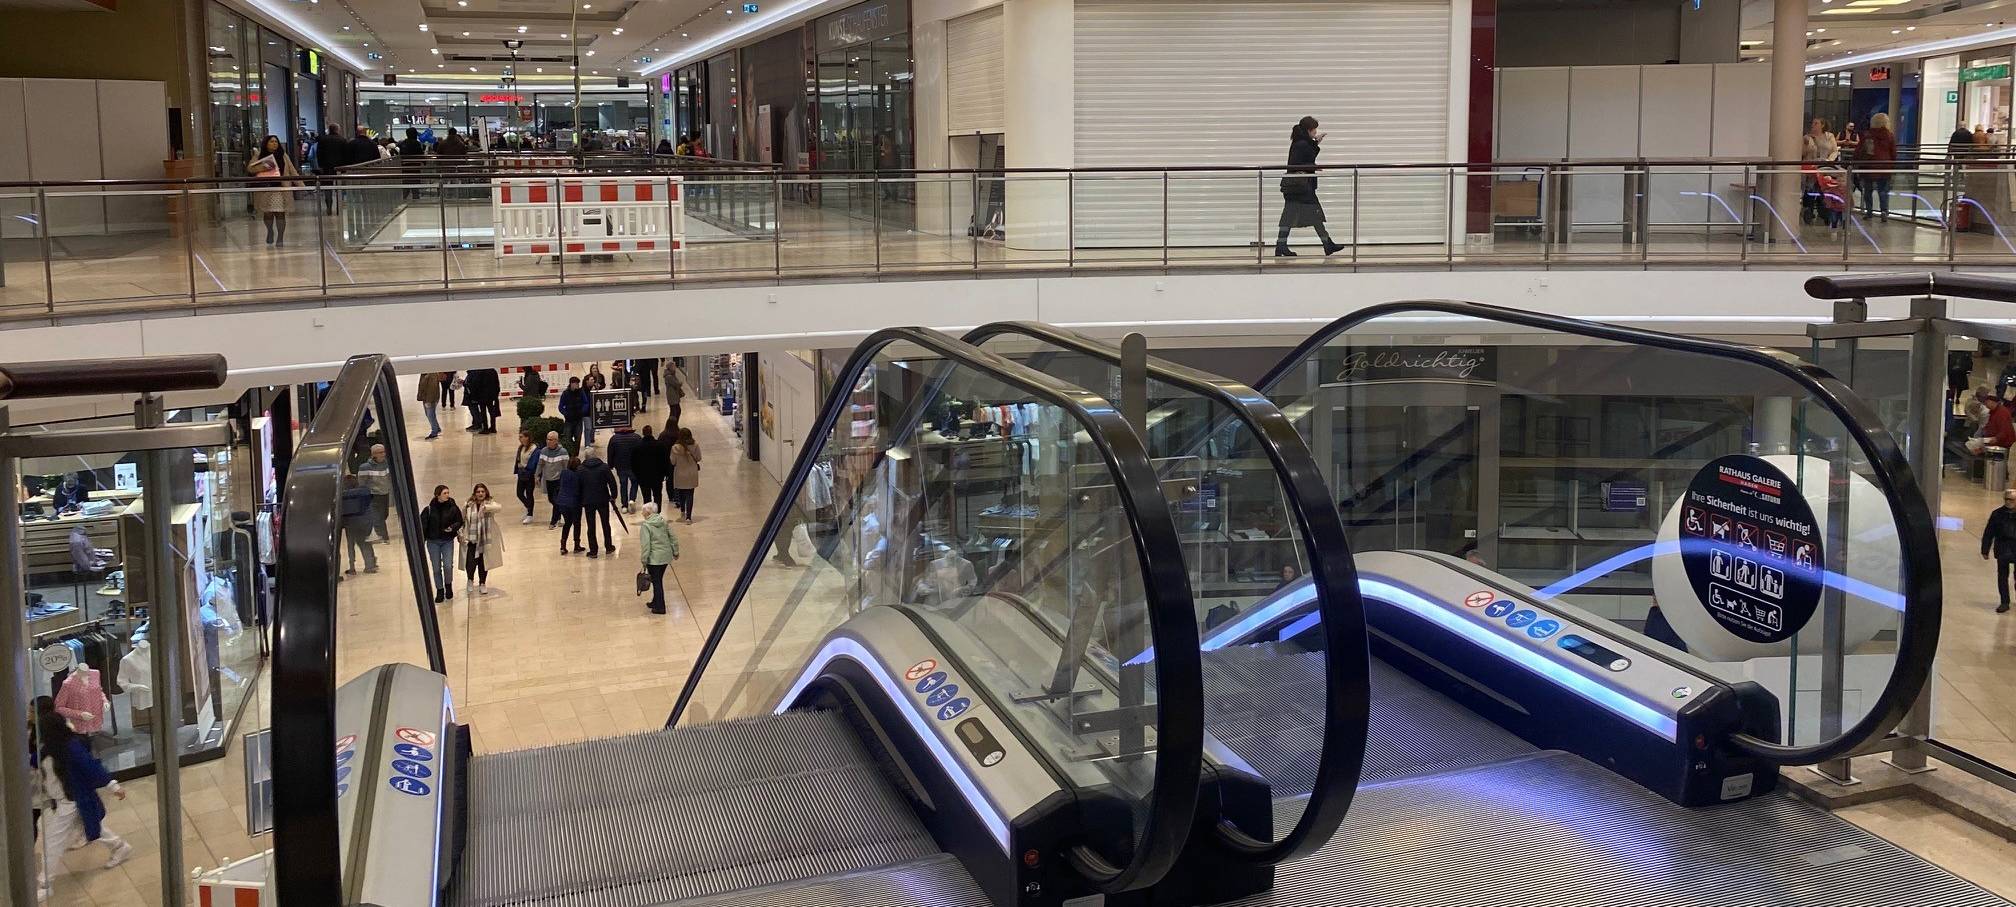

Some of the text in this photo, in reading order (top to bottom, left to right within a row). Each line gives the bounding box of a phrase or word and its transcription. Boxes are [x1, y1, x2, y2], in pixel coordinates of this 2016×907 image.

[1336, 350, 1480, 381] Goldrichtig
[1719, 465, 1781, 489] RATHAUS GALERIE
[1691, 490, 1810, 536] Ihre Sicherheit ist uns wichtig!
[45, 655, 68, 665] 20%
